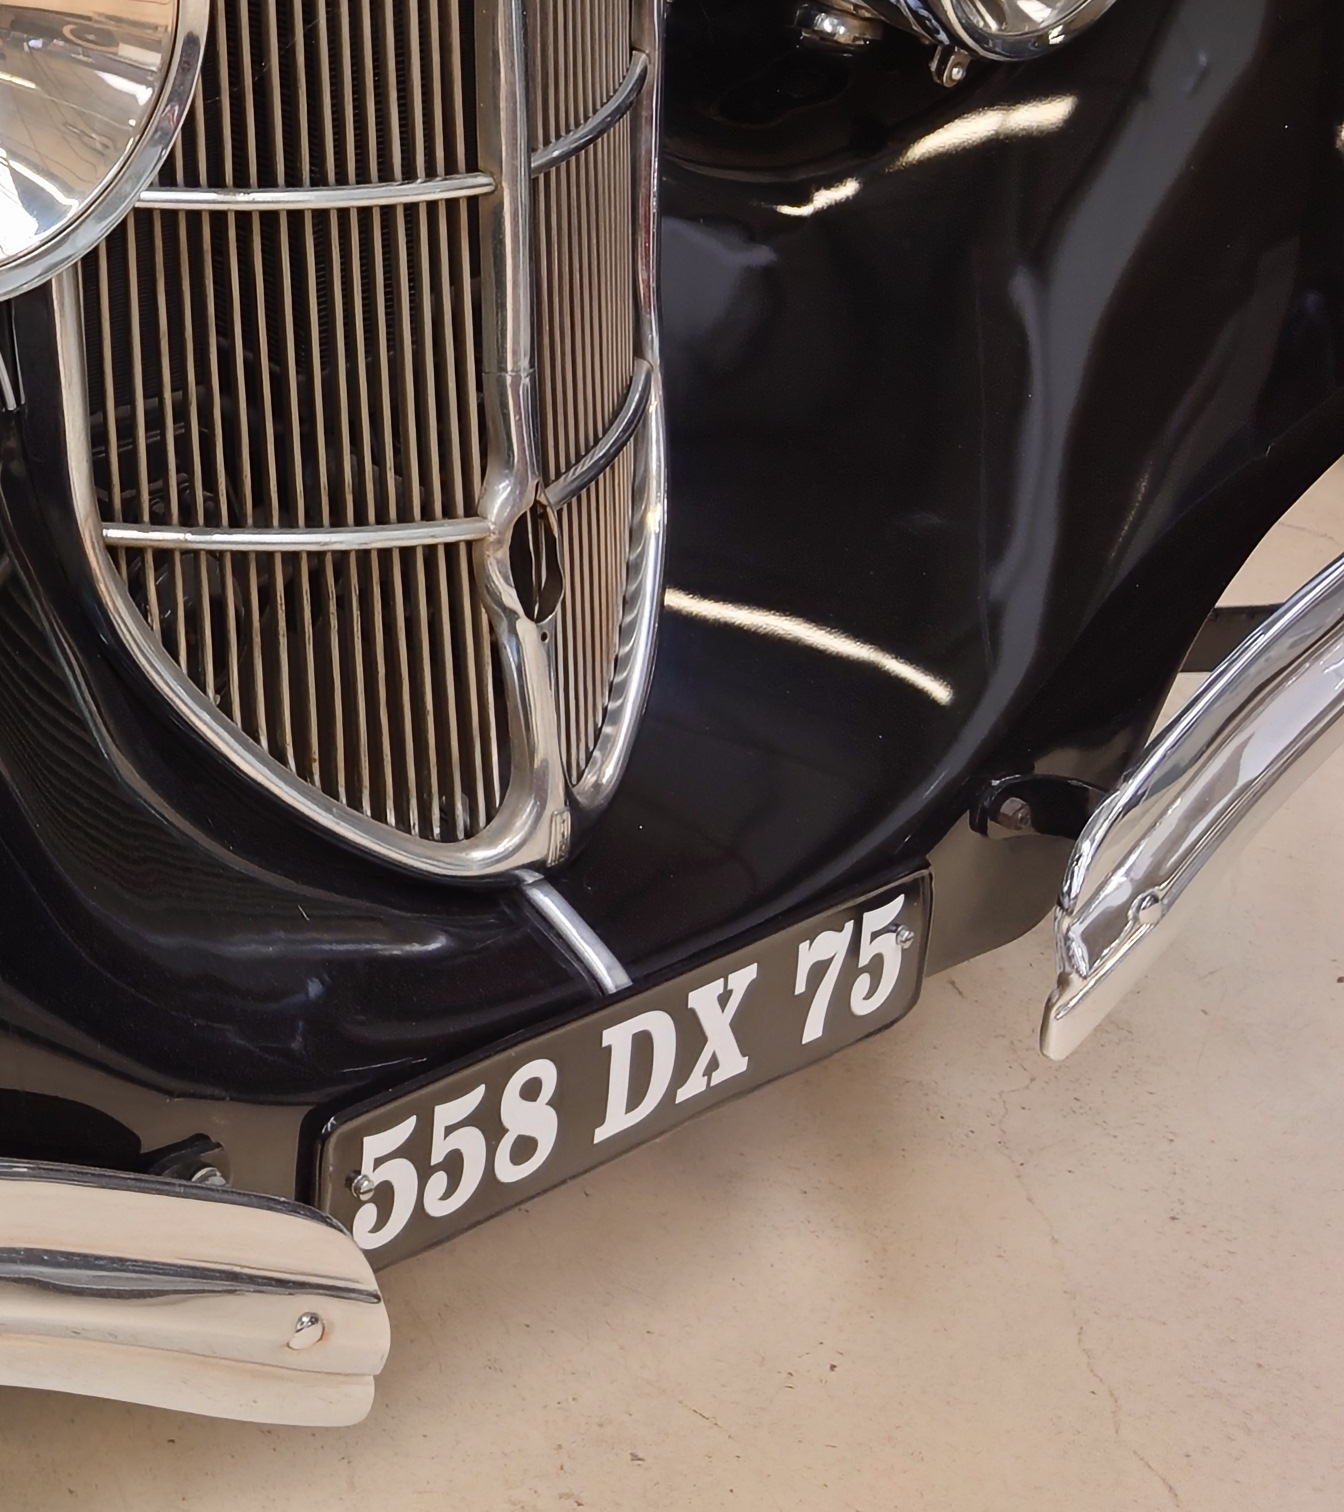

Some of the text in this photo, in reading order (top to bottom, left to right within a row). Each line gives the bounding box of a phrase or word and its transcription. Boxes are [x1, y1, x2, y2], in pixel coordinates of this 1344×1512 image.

[351, 893, 906, 1251] 558 DX 75
